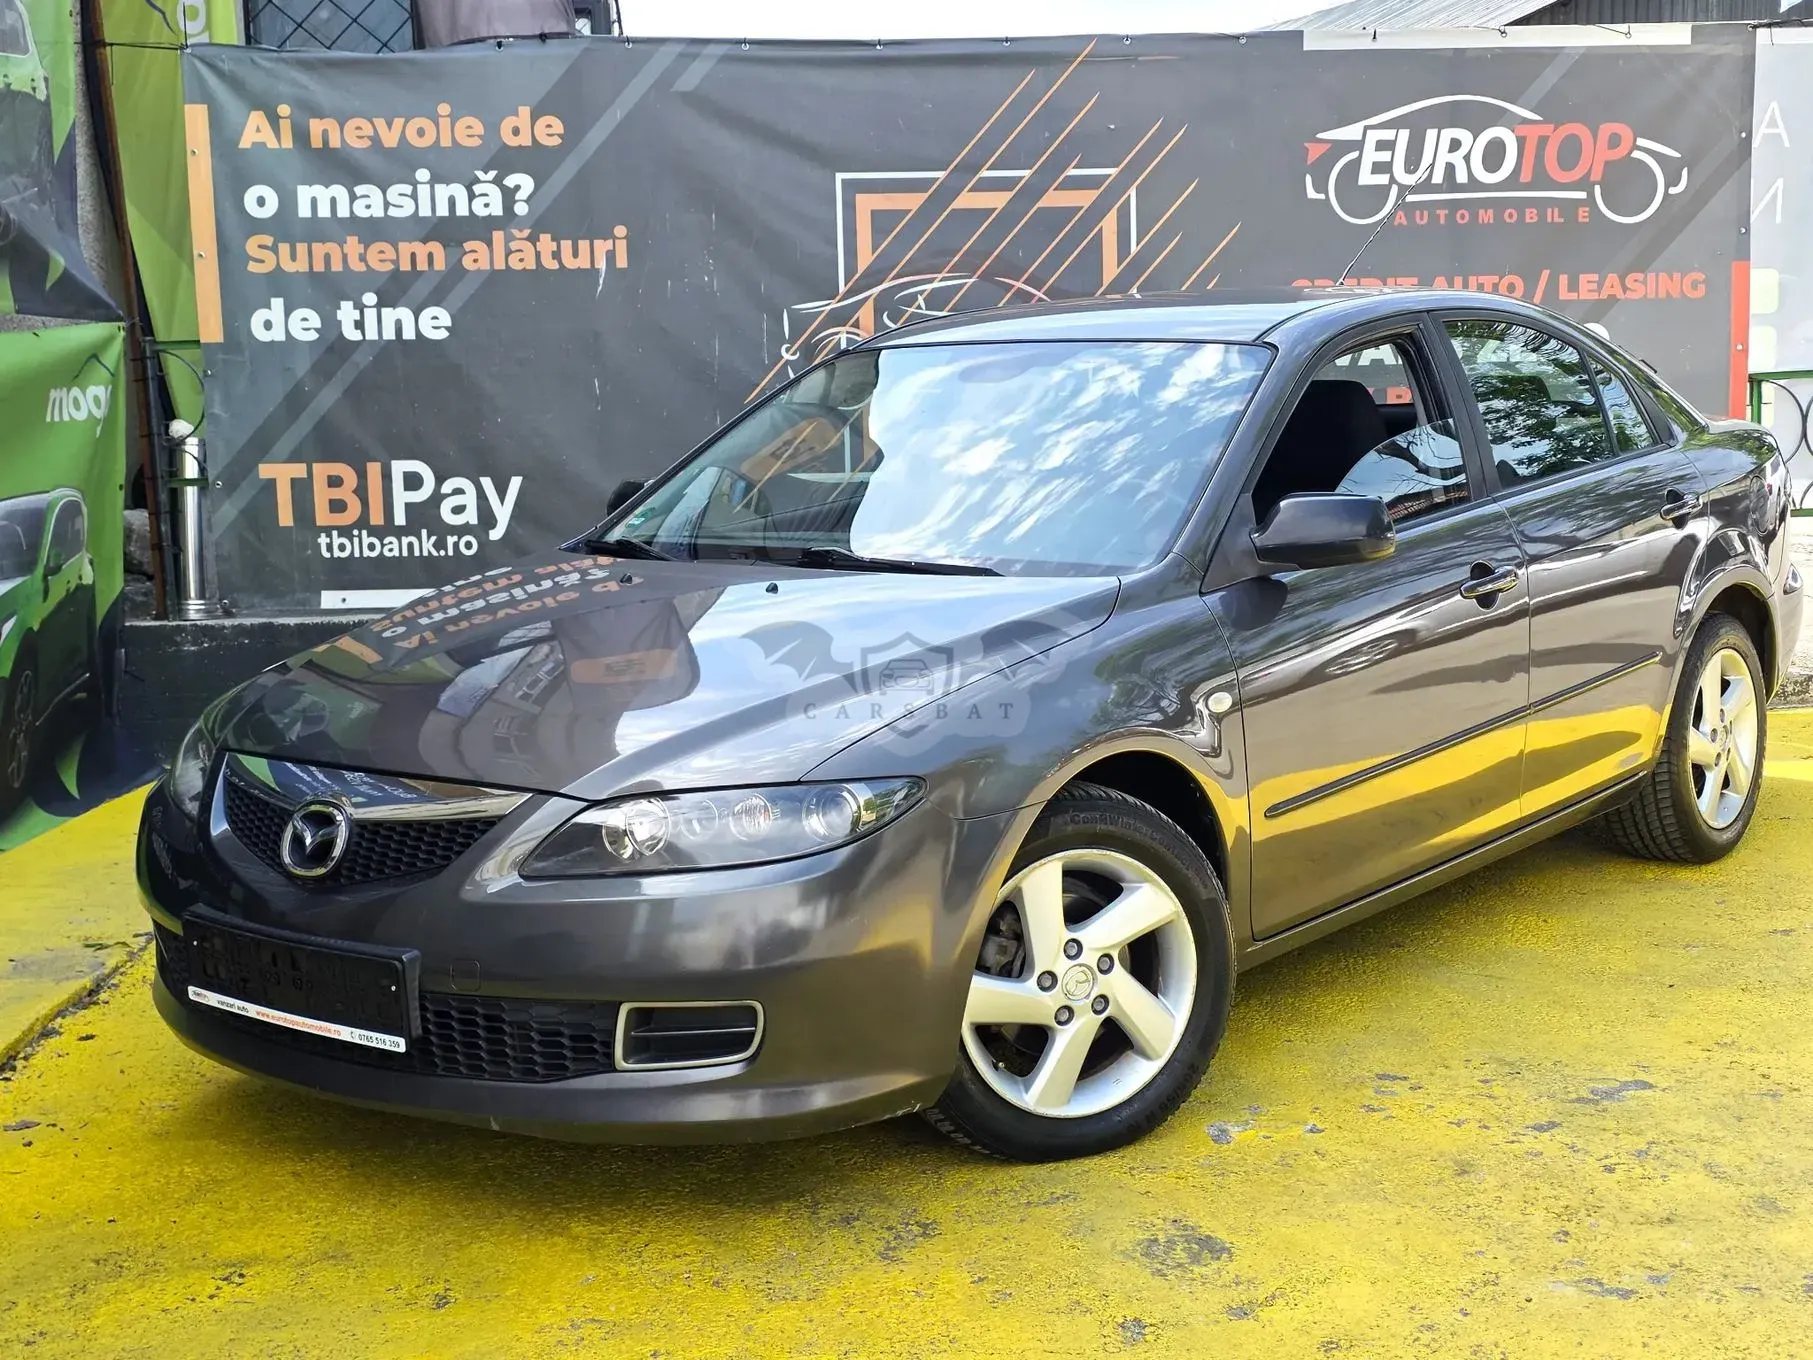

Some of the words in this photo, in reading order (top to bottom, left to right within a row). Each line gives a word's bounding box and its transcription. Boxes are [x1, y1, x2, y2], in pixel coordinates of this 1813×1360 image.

[238, 104, 293, 149] Ai
[309, 103, 485, 149] nevoie
[500, 106, 565, 147] de
[1357, 122, 1634, 186] EUROTOP
[243, 184, 279, 218] o
[297, 168, 535, 218] masină?
[1394, 207, 1590, 226] AUTOMOBILE
[245, 234, 446, 274] Suntem
[462, 224, 628, 272] alături
[1558, 272, 1706, 300] LEASING
[250, 297, 322, 342] de
[337, 292, 452, 341] tine
[258, 460, 523, 541] TBIPay
[317, 529, 478, 558] tbibank.ro
[358, 1033, 374, 1043] 0765
[375, 1036, 387, 1046] 516
[388, 1039, 400, 1049] 359
